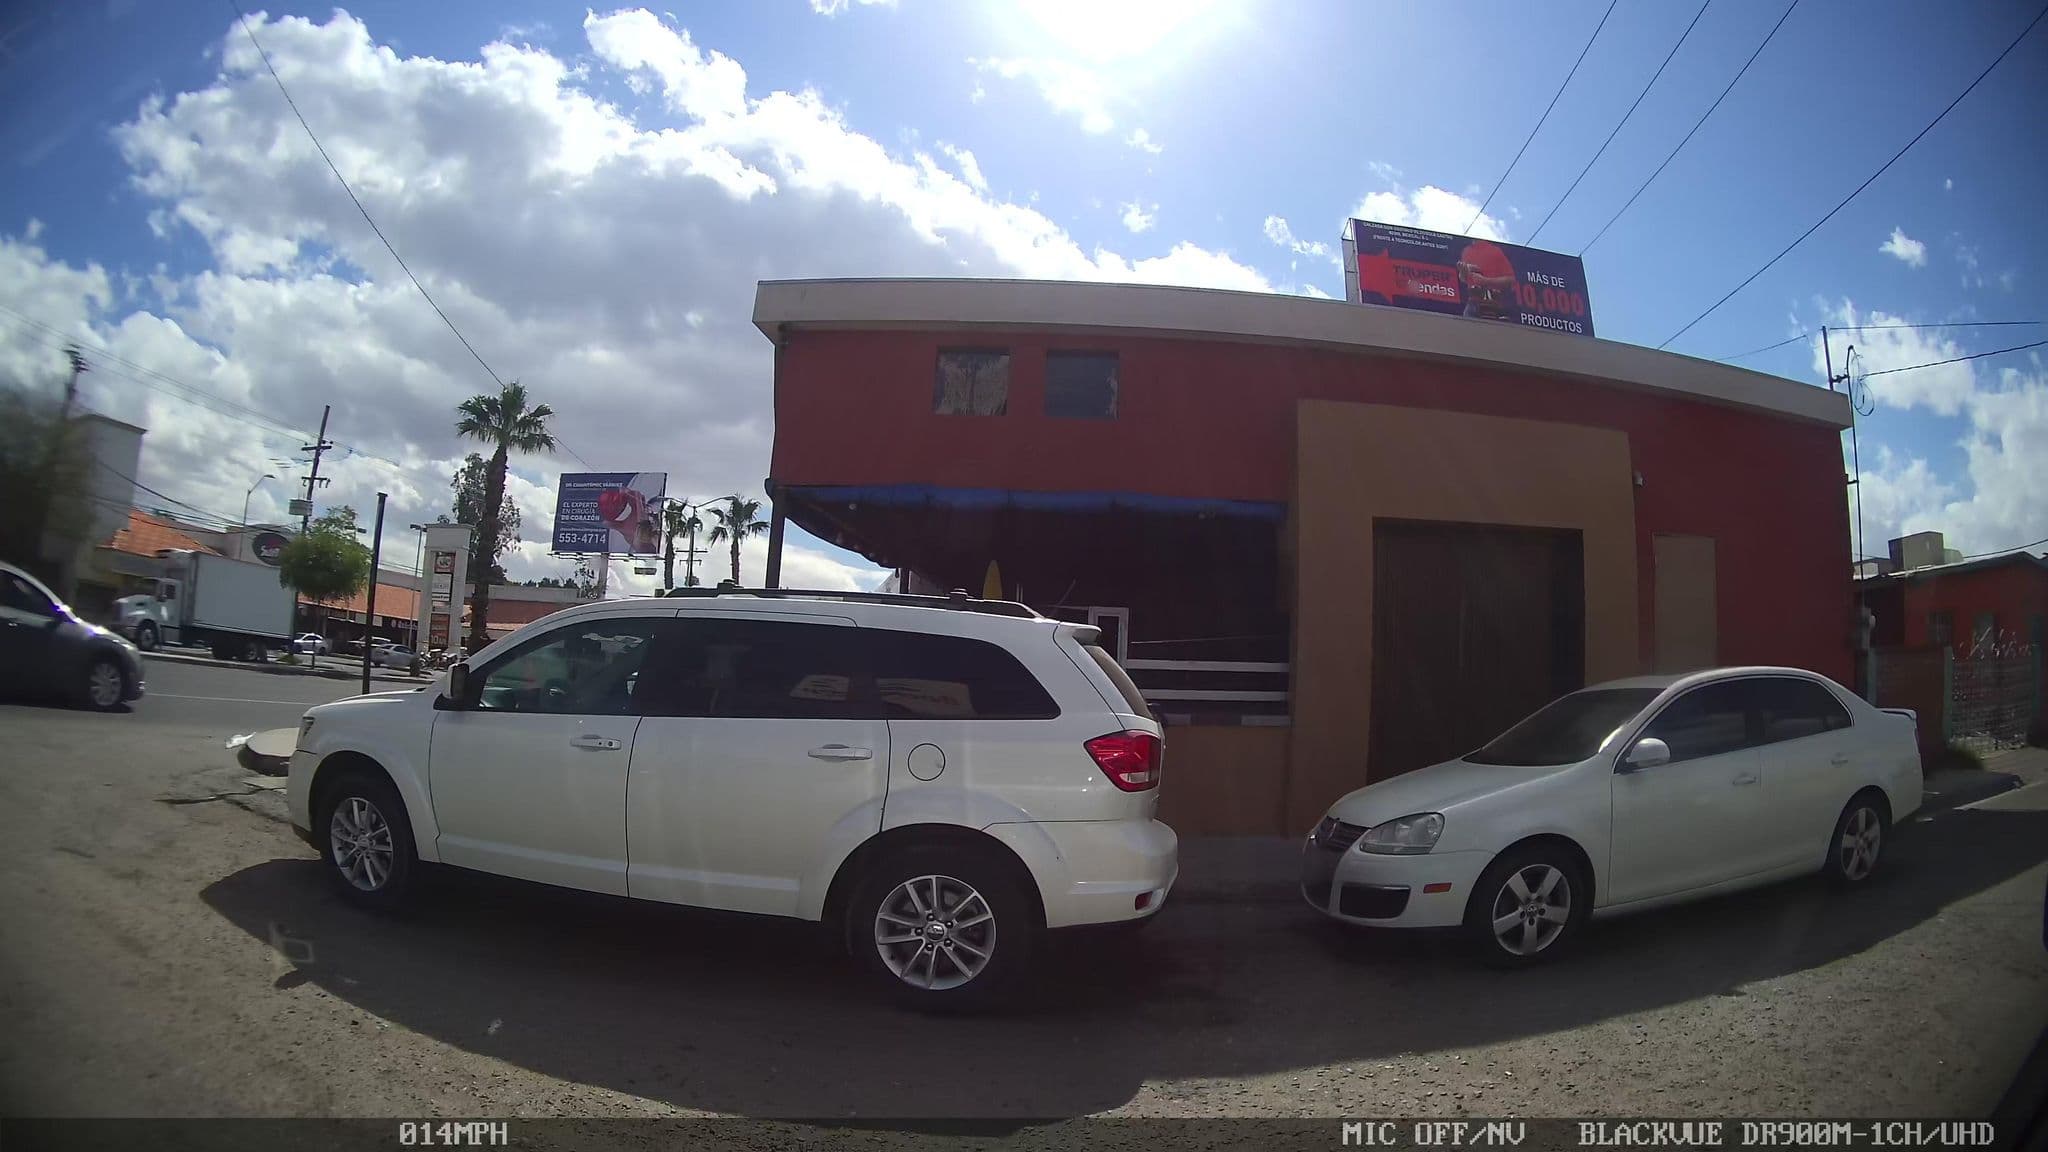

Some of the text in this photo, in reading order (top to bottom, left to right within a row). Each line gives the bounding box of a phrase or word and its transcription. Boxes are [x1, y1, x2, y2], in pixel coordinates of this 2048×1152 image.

[1527, 271, 1565, 288] MÁS DE
[1520, 313, 1583, 334] PRODUCTOS
[559, 533, 606, 544] 553-4714
